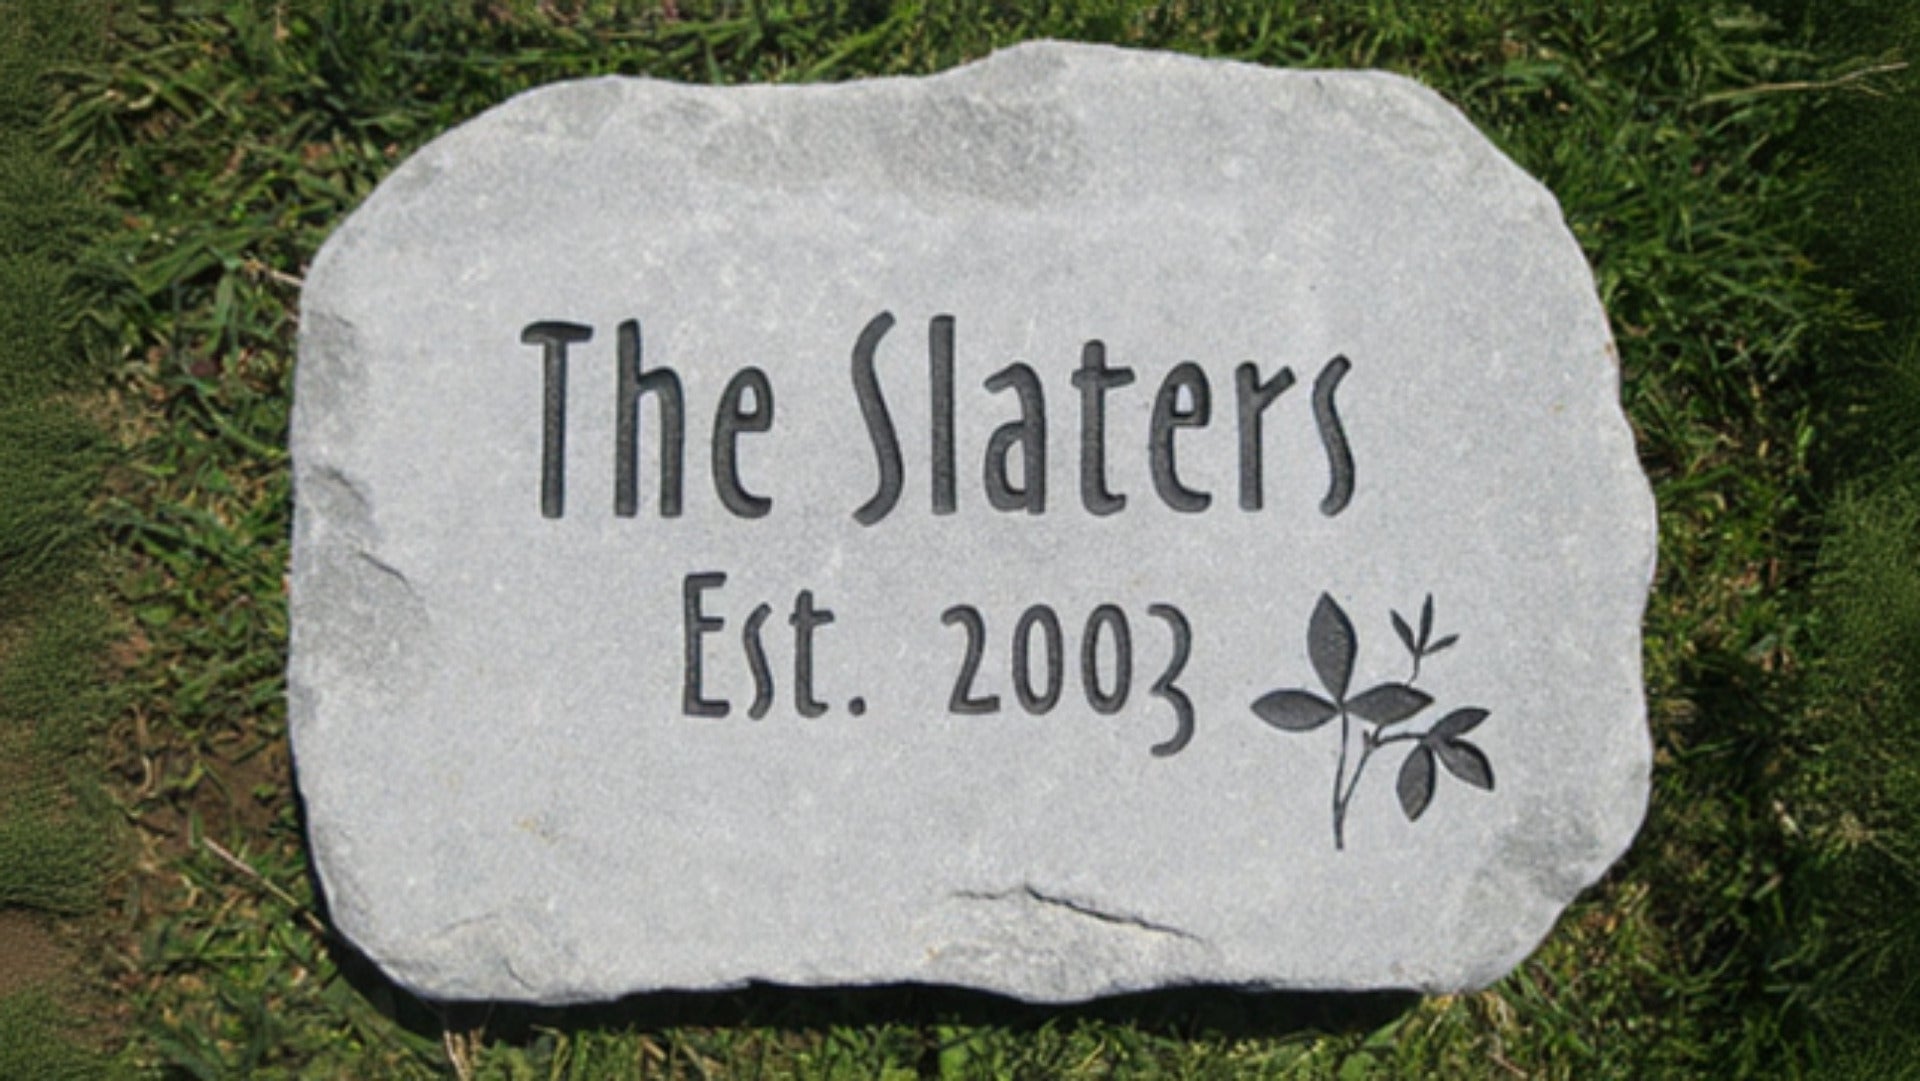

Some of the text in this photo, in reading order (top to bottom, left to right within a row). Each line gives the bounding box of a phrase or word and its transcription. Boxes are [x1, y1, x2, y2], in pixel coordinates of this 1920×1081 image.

[520, 310, 1356, 526] The Slaters
[682, 571, 1195, 757] Est. 2003
